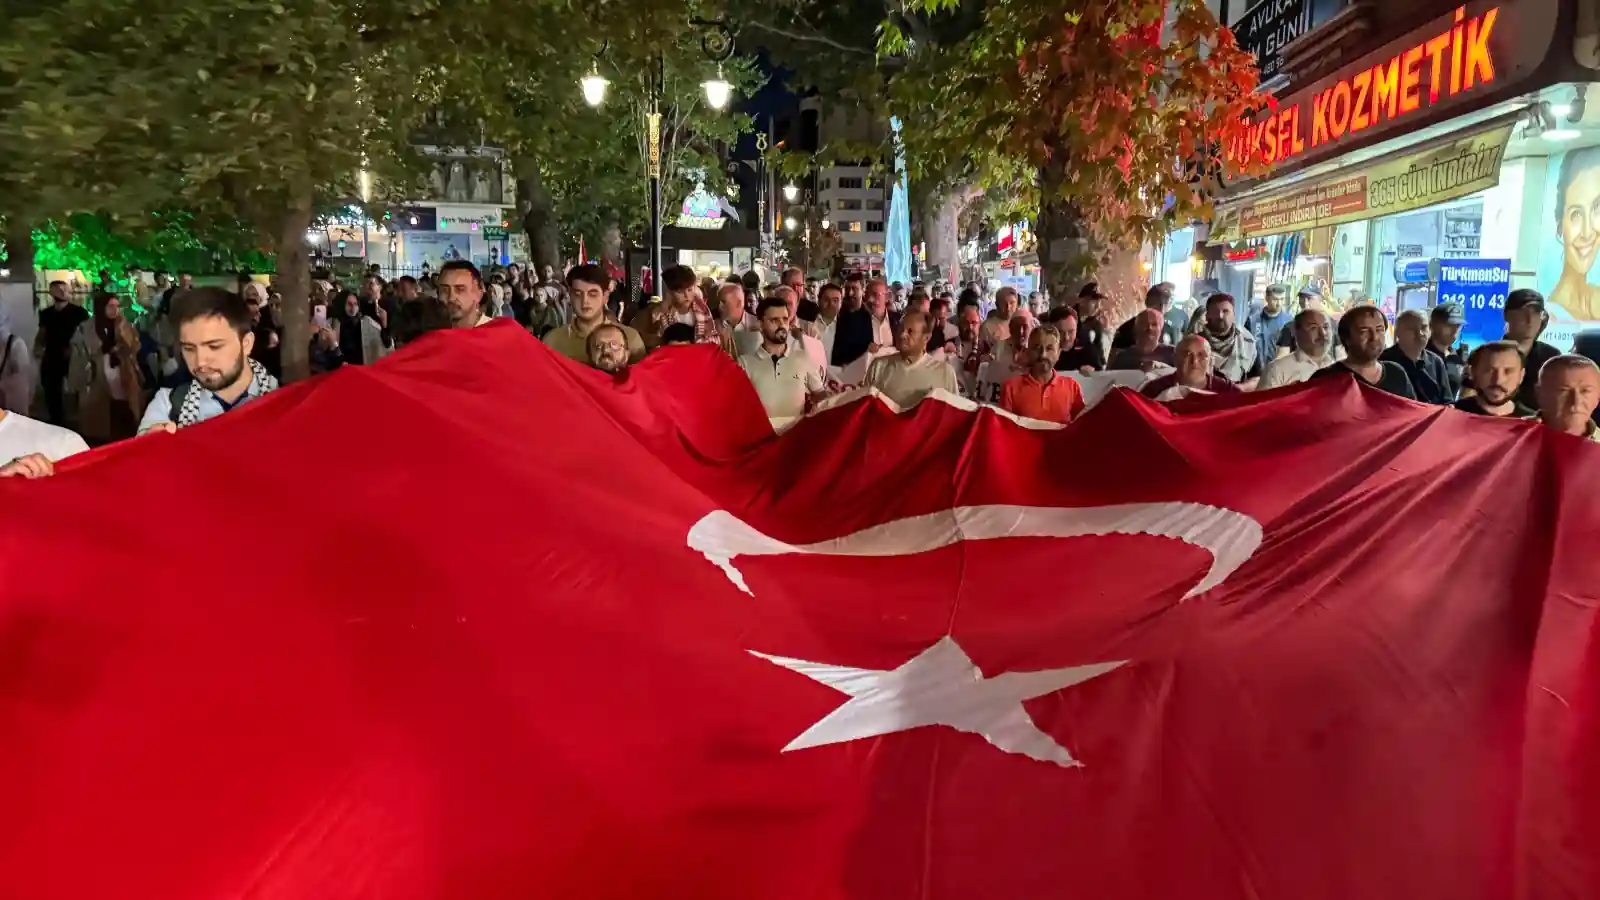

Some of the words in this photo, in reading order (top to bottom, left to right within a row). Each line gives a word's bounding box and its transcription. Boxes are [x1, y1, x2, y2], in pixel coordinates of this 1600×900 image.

[1249, 0, 1297, 37] AVUKA
[1311, 4, 1499, 148] KOZMETİK
[1370, 176, 1396, 208] 365
[1398, 163, 1429, 202] GÜN
[1430, 143, 1500, 194] İNDİRİM
[1441, 266, 1508, 282] TürkmenSu
[1470, 294, 1485, 309] 10
[1488, 294, 1504, 309] 43
